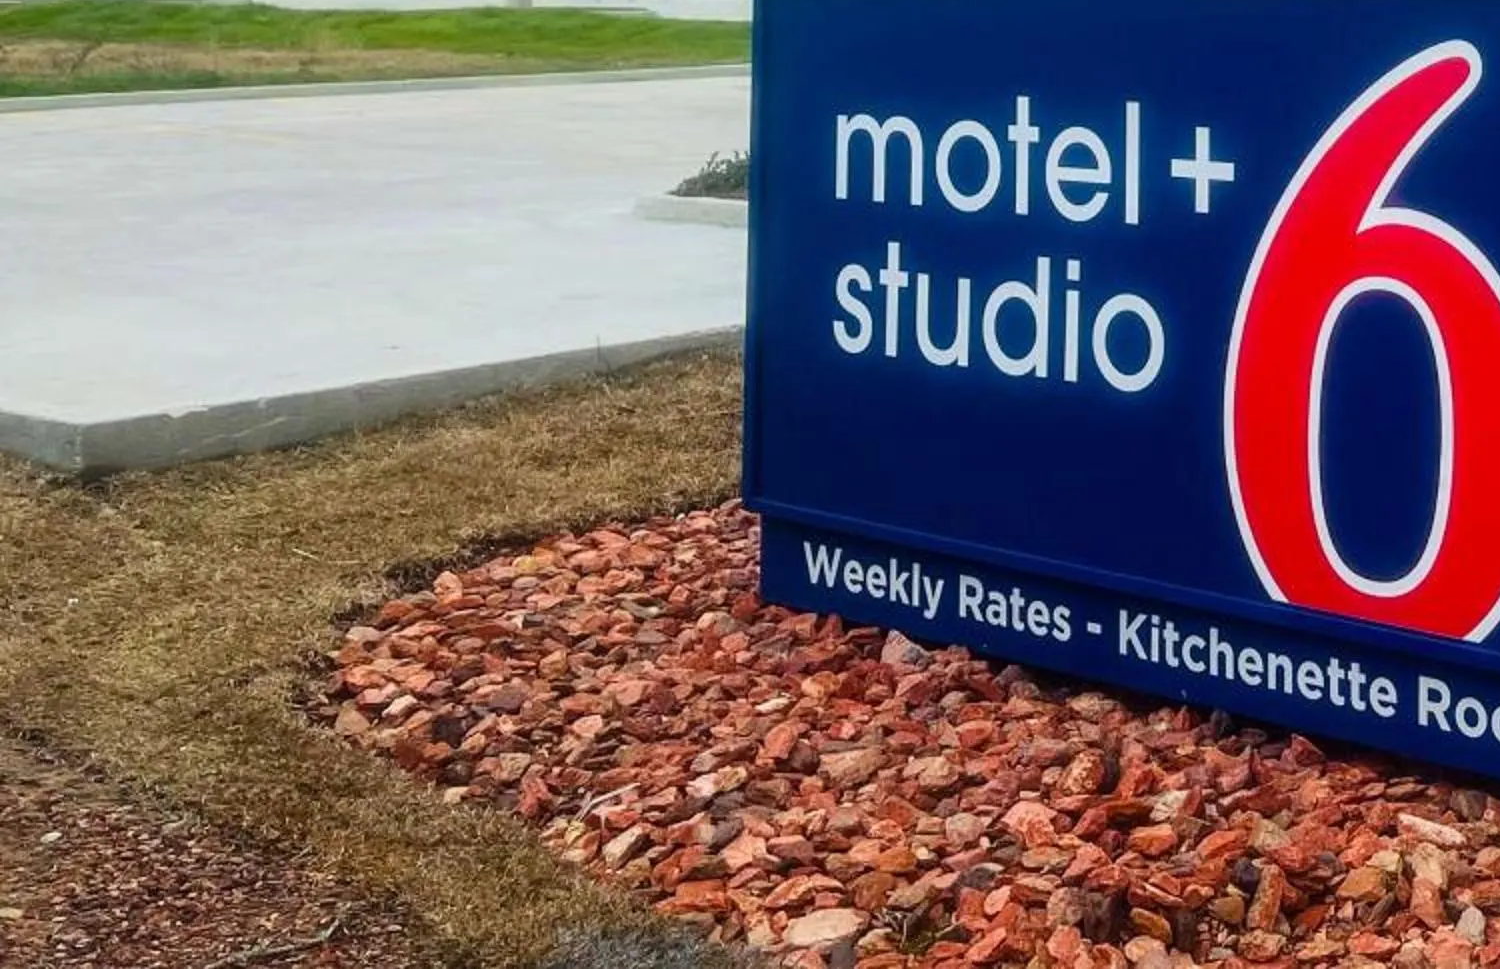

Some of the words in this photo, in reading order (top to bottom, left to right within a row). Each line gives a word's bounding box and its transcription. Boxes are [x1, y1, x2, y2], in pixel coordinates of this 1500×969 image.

[835, 96, 1140, 225] motel
[1170, 126, 1235, 214] +
[833, 241, 1165, 392] studio
[803, 541, 945, 620] Weekly
[958, 574, 1072, 642] Rates
[1118, 609, 1398, 718] Kitchenette
